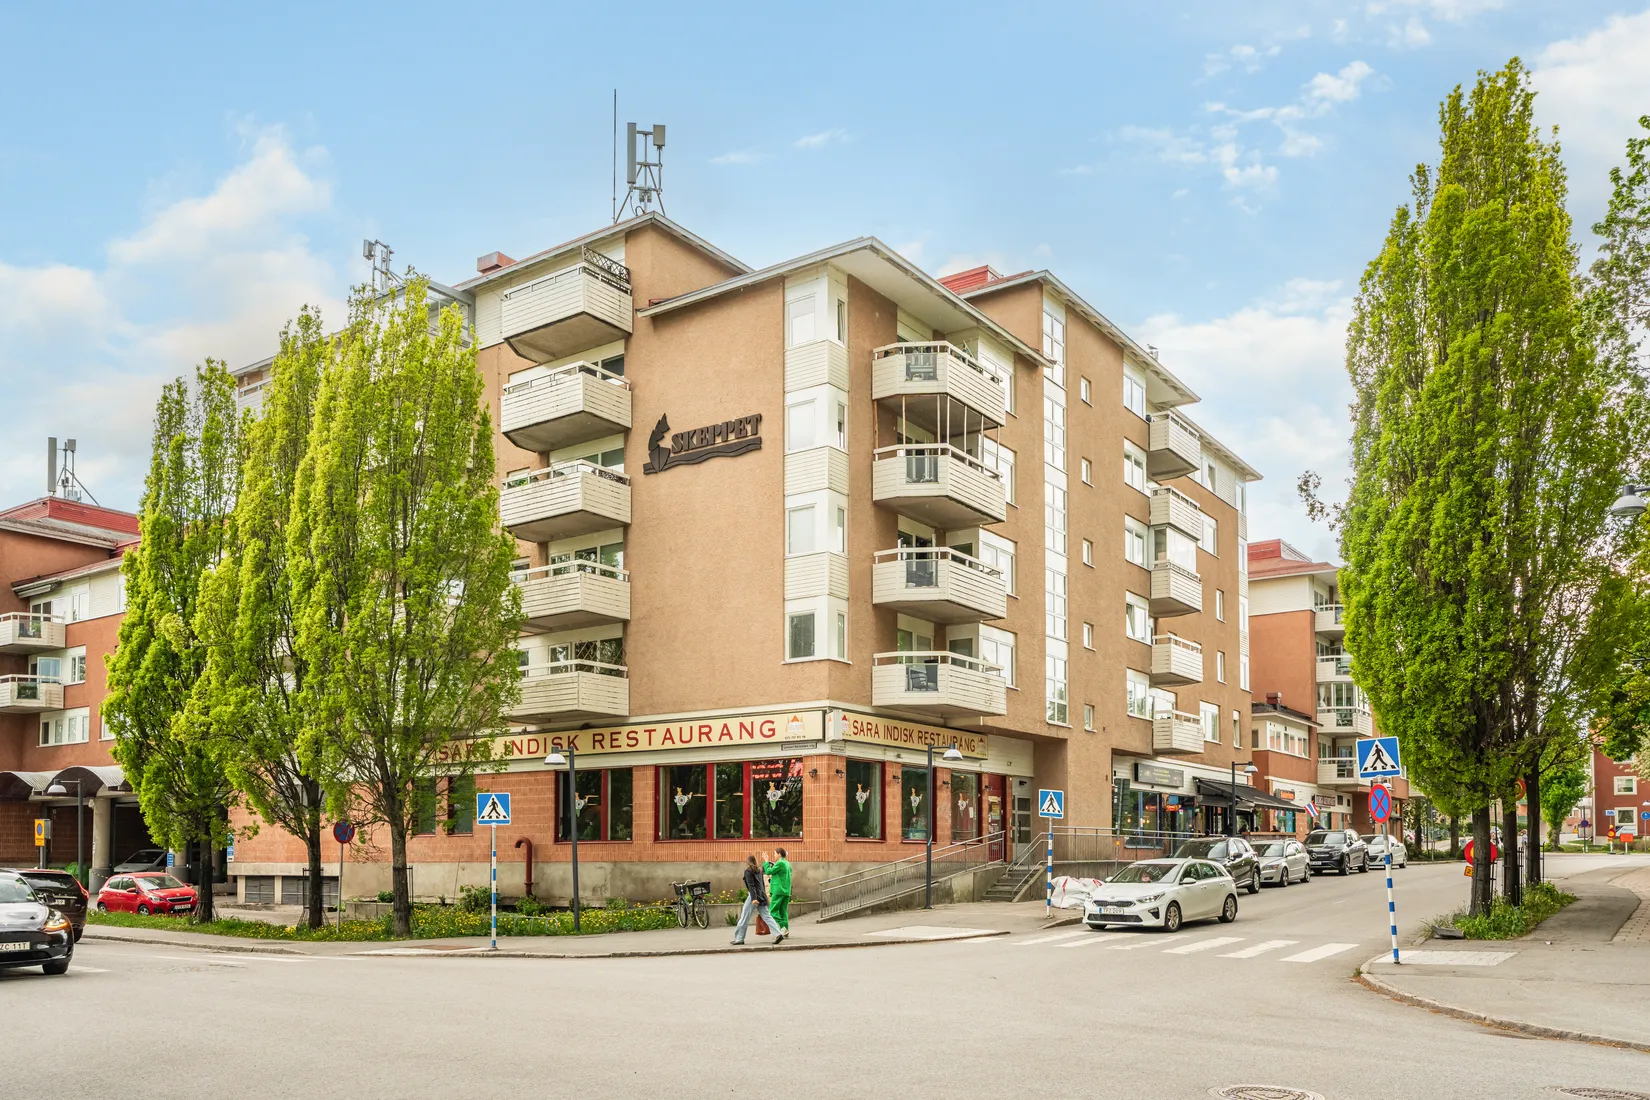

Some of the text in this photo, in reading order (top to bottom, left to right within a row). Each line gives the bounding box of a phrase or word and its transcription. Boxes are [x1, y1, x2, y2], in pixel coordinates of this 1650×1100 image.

[671, 414, 761, 454] SKEPPET
[504, 734, 580, 757] INDISK
[592, 719, 776, 750] RESTAURANG
[852, 719, 976, 752] SARA INDISK RESTAURANG
